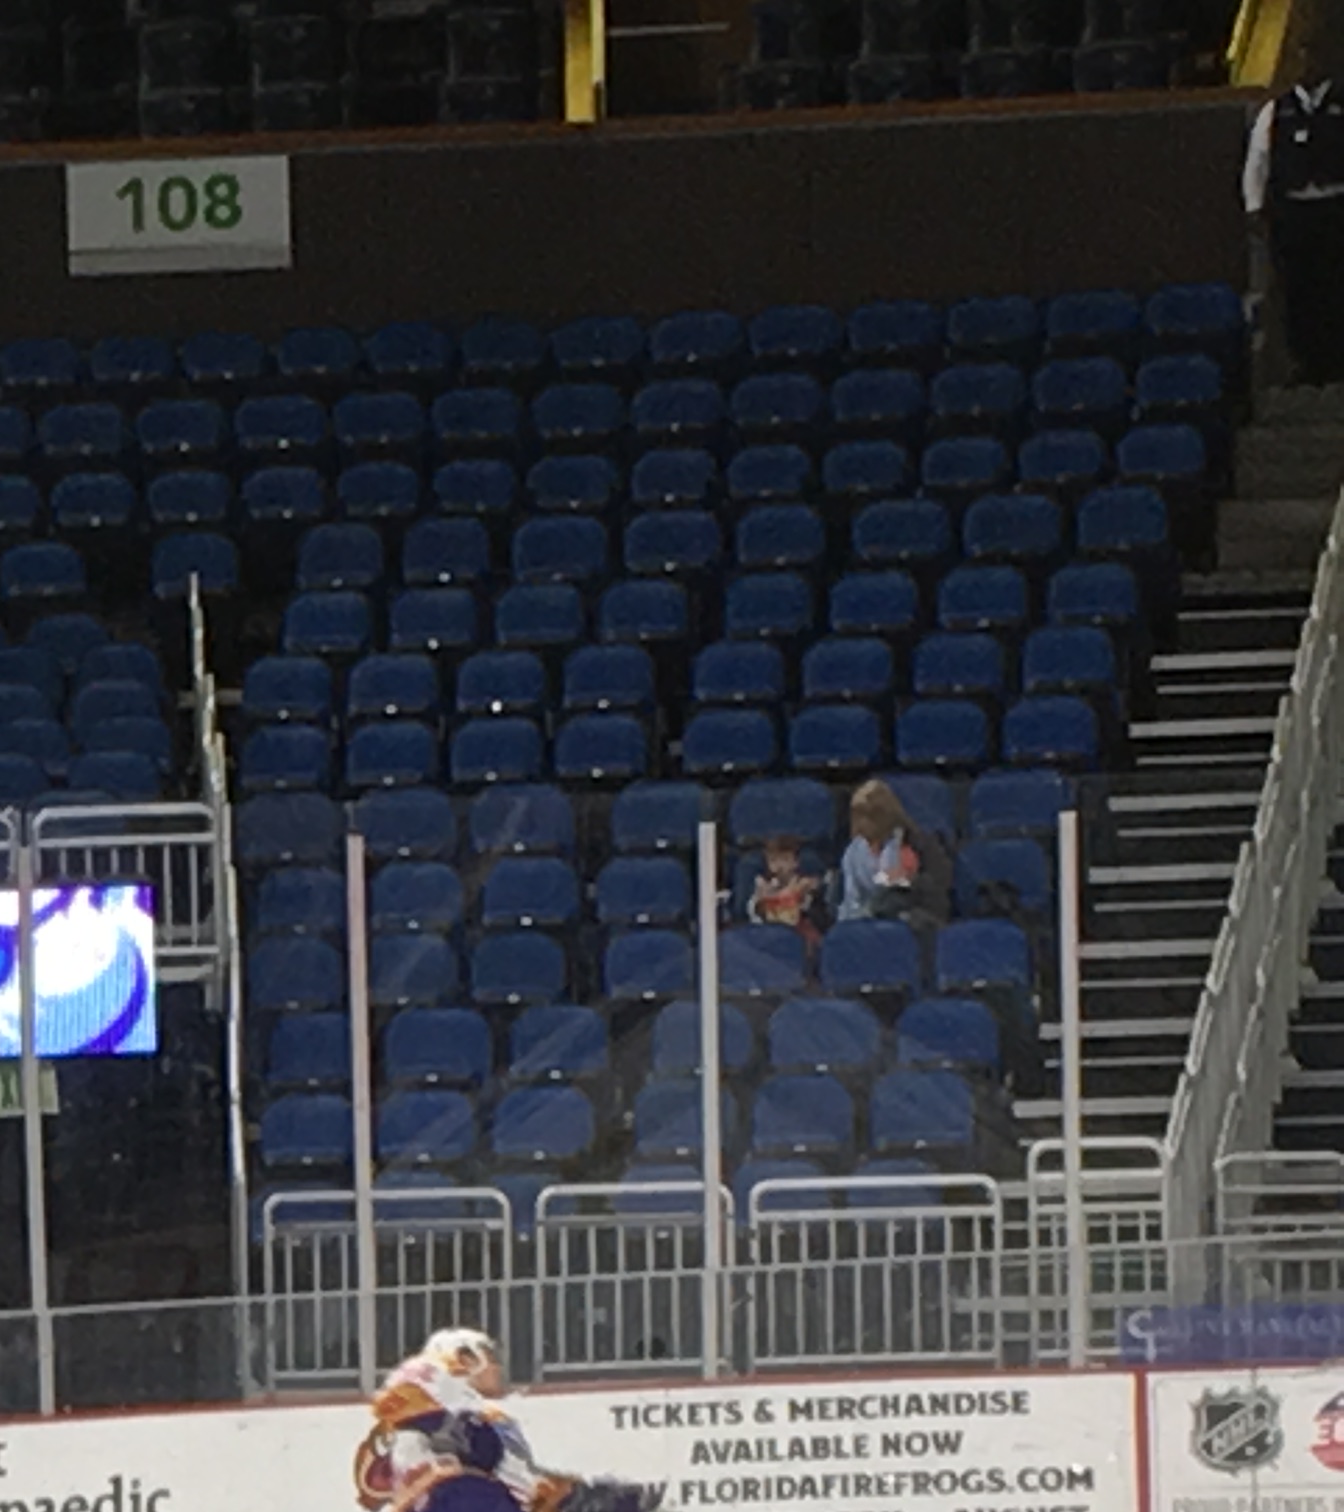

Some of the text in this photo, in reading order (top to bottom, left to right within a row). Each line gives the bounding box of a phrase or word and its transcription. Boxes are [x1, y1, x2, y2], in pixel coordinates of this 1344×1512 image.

[115, 174, 243, 234] 108
[609, 1390, 1030, 1430] TICKETS & MERCHANDISE
[690, 1430, 964, 1466] AVAILABLE NOW
